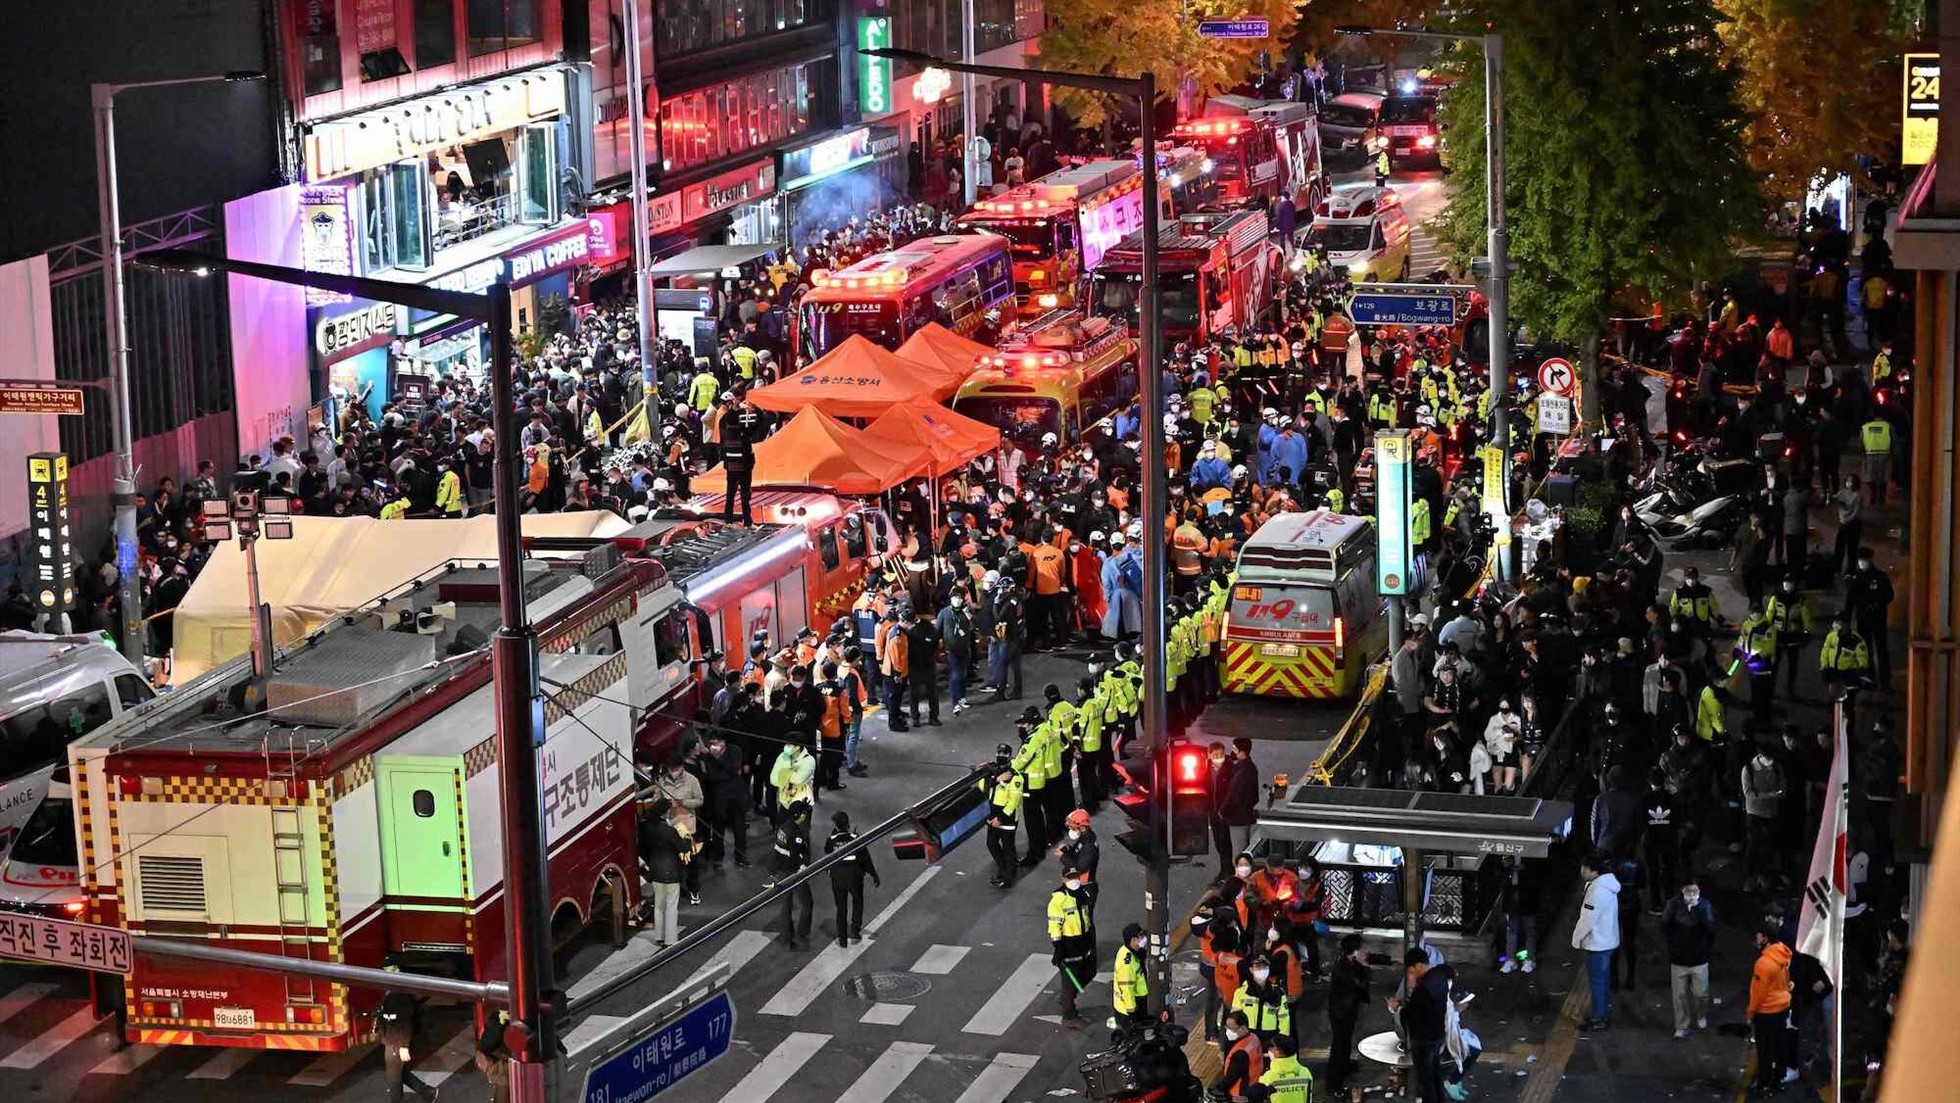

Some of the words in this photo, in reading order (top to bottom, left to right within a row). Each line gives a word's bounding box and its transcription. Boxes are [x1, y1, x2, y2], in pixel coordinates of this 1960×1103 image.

[1911, 76, 1940, 100] 24
[546, 233, 588, 268] COFFEE
[1401, 313, 1451, 323] Bogwang-ro
[1415, 300, 1451, 312] 보광로
[36, 485, 47, 499] 4
[36, 509, 52, 559] 이태원
[1246, 598, 1296, 621] 119
[1259, 630, 1301, 639] AMBULANCE
[544, 741, 621, 829] 구조통제단
[0, 919, 36, 955] 직진
[43, 924, 61, 958] 후
[69, 928, 128, 969] 좌회전
[141, 987, 180, 998] 서울특별시
[182, 988, 228, 1000] 소방재난본부
[707, 1012, 728, 1041] 177
[632, 1026, 688, 1074] 이태원로
